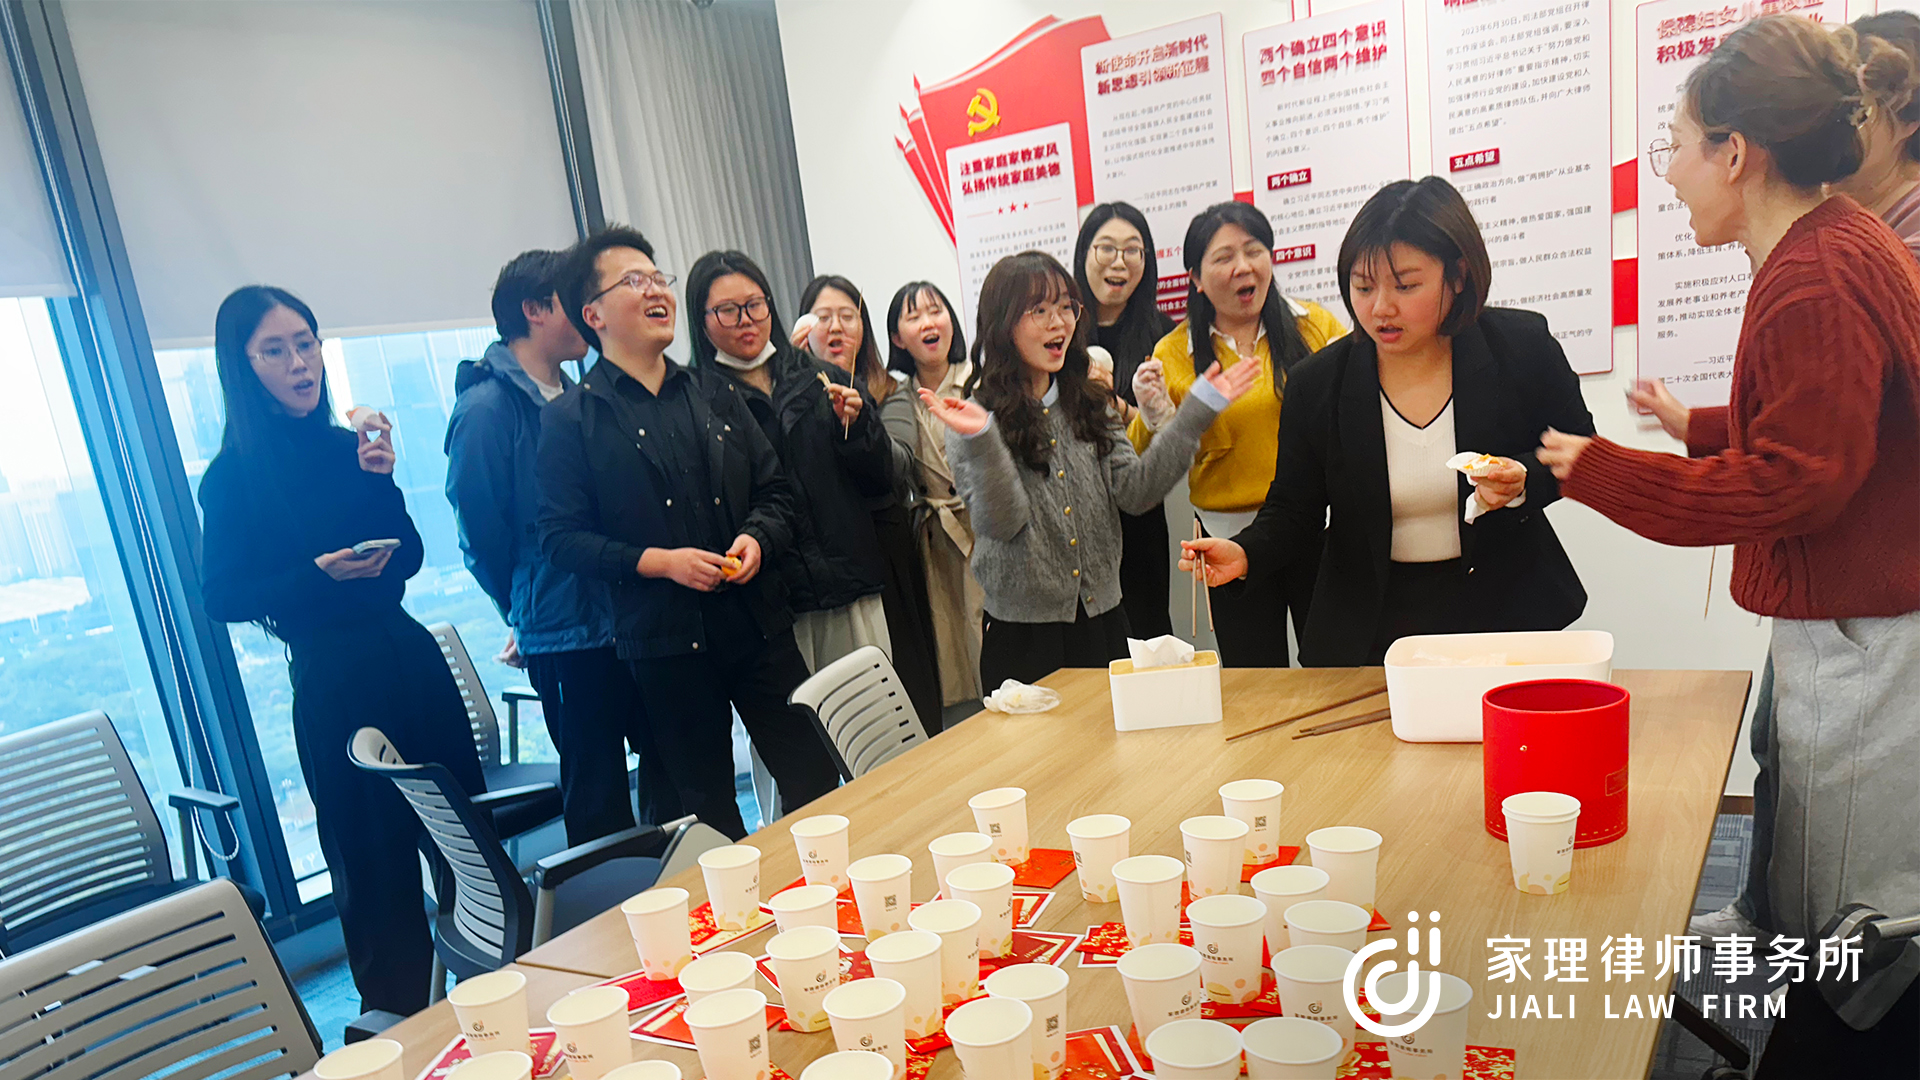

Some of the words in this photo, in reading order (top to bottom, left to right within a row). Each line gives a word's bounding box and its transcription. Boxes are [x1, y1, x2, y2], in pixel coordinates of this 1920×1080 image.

[1095, 33, 1209, 75] 新使命开启新时代
[1260, 20, 1386, 65] 两个确立四个意识
[1261, 43, 1387, 87] 四个自信两个维护
[960, 142, 1059, 176] 注重家庭家教家风
[1454, 150, 1495, 168] 五点希望
[962, 162, 1061, 196] 弘扬传统家庭美德
[1271, 170, 1308, 188] 两个确立
[1275, 246, 1312, 262] 四个意识
[1657, 289, 1749, 308] 发展养老事业和养老产
